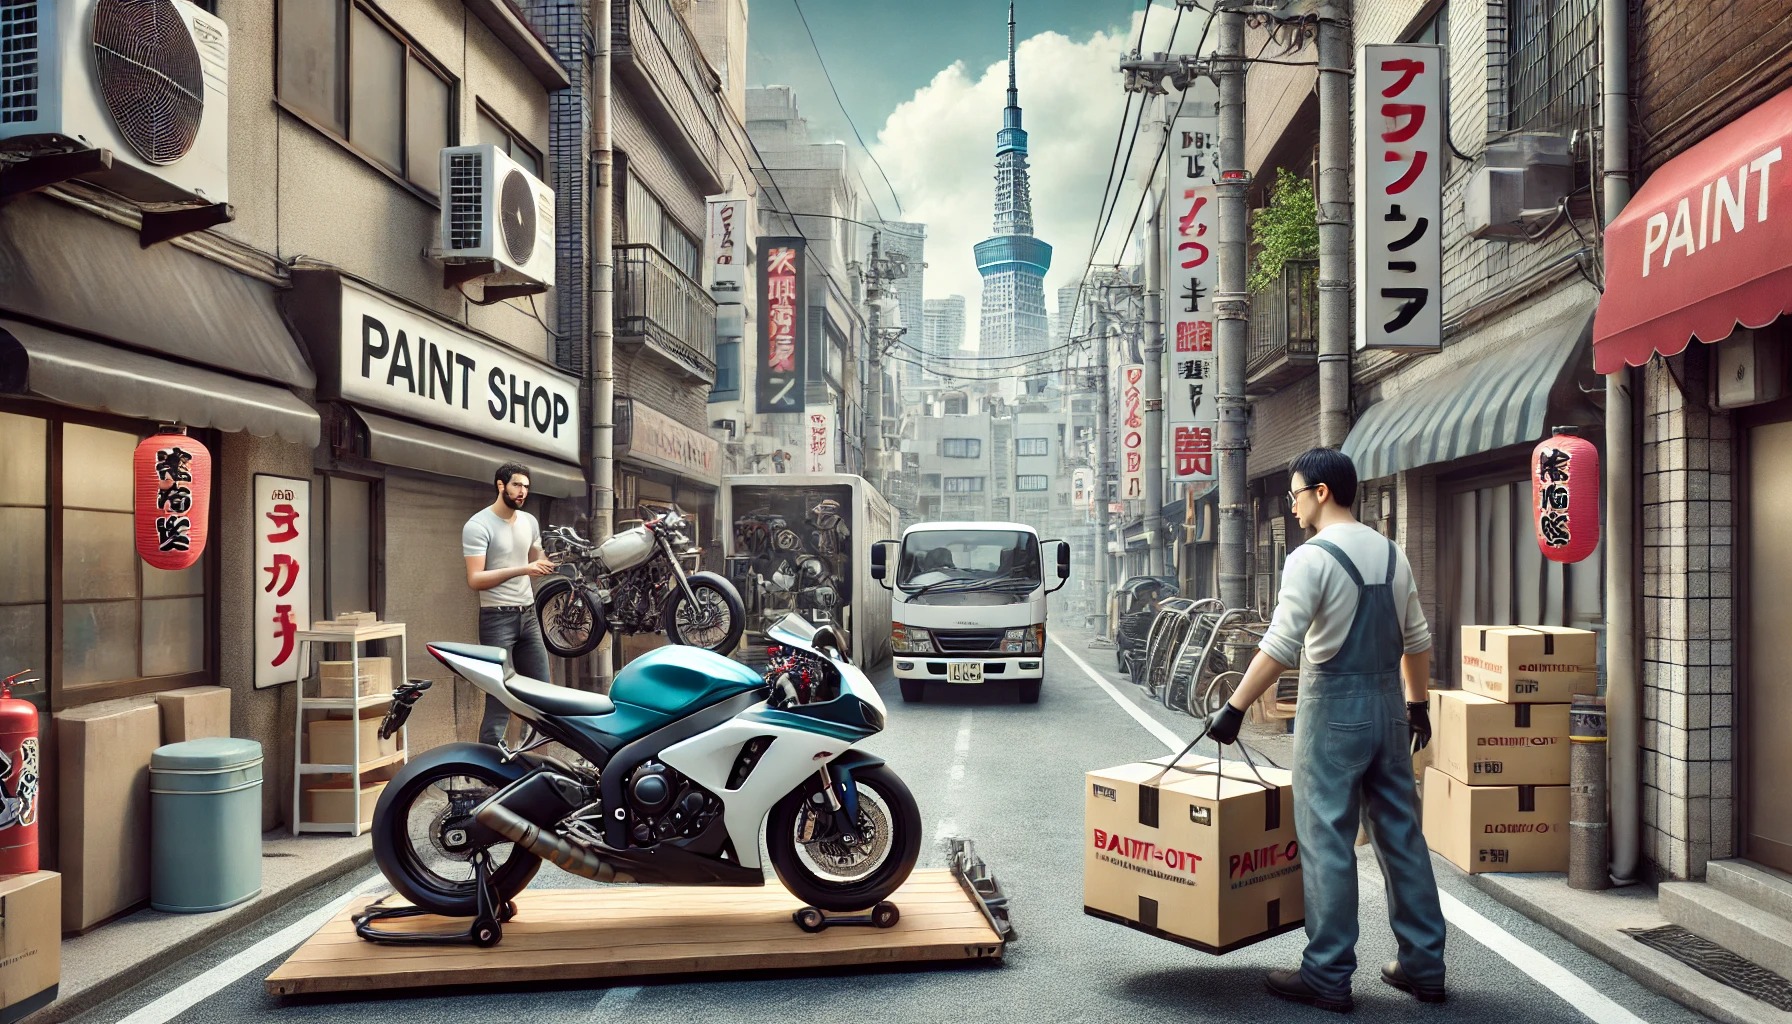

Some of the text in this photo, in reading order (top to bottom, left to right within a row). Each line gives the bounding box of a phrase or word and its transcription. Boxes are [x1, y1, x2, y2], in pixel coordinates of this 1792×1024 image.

[1643, 146, 1782, 278] PAINT
[361, 314, 569, 438] PAINT SHOP
